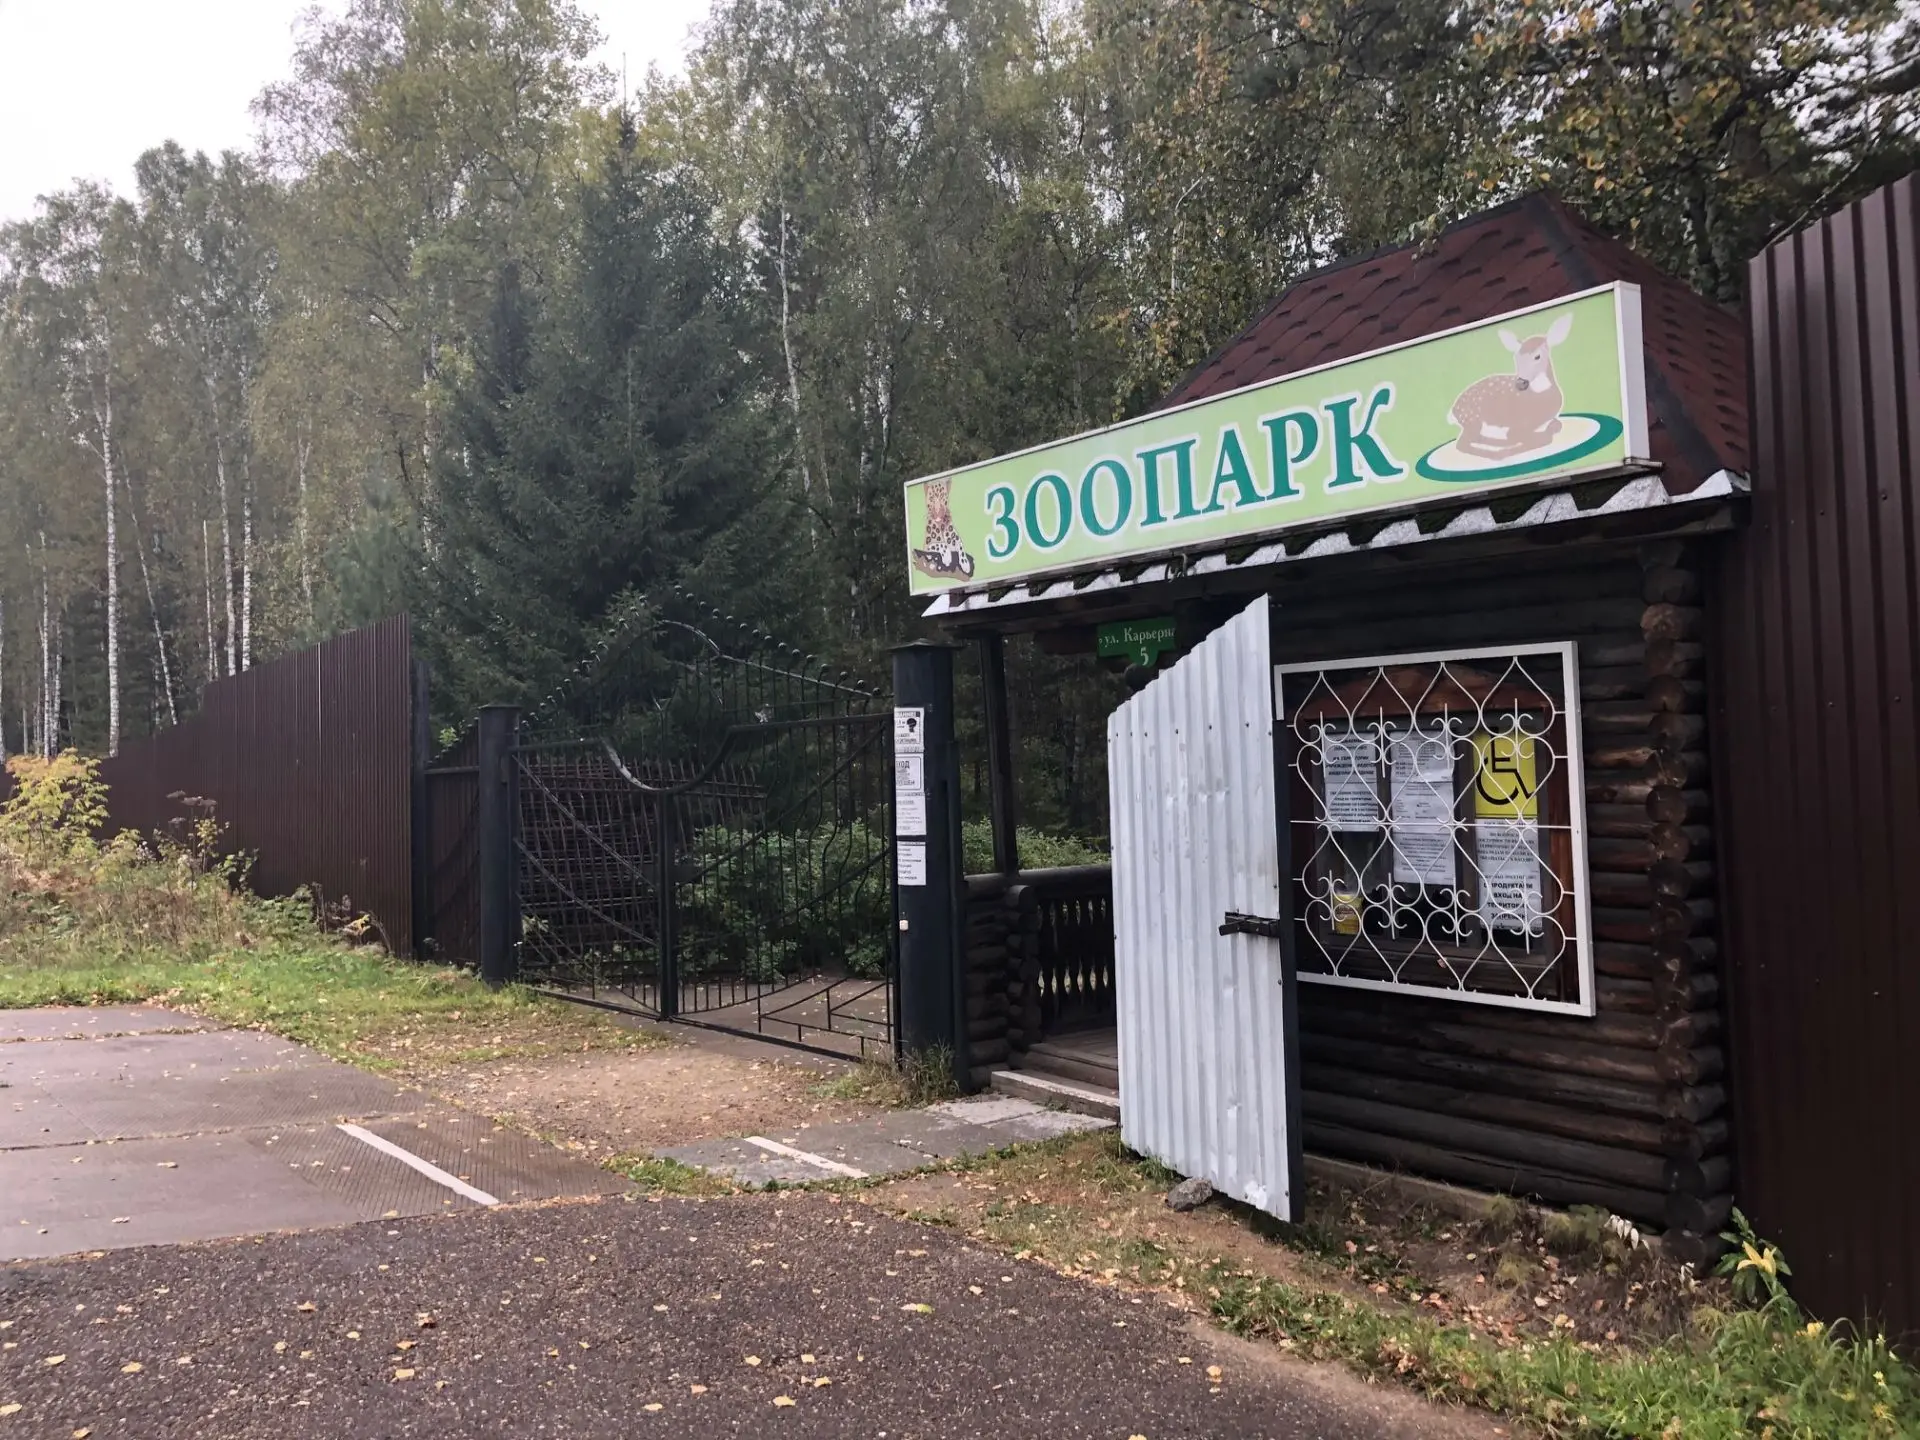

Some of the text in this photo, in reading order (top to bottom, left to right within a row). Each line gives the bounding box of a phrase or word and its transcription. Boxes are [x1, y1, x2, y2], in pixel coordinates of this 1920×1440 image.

[985, 386, 1404, 558] ЗООПАРК
[1104, 635, 1119, 648] ул.
[1140, 646, 1149, 666] 5
